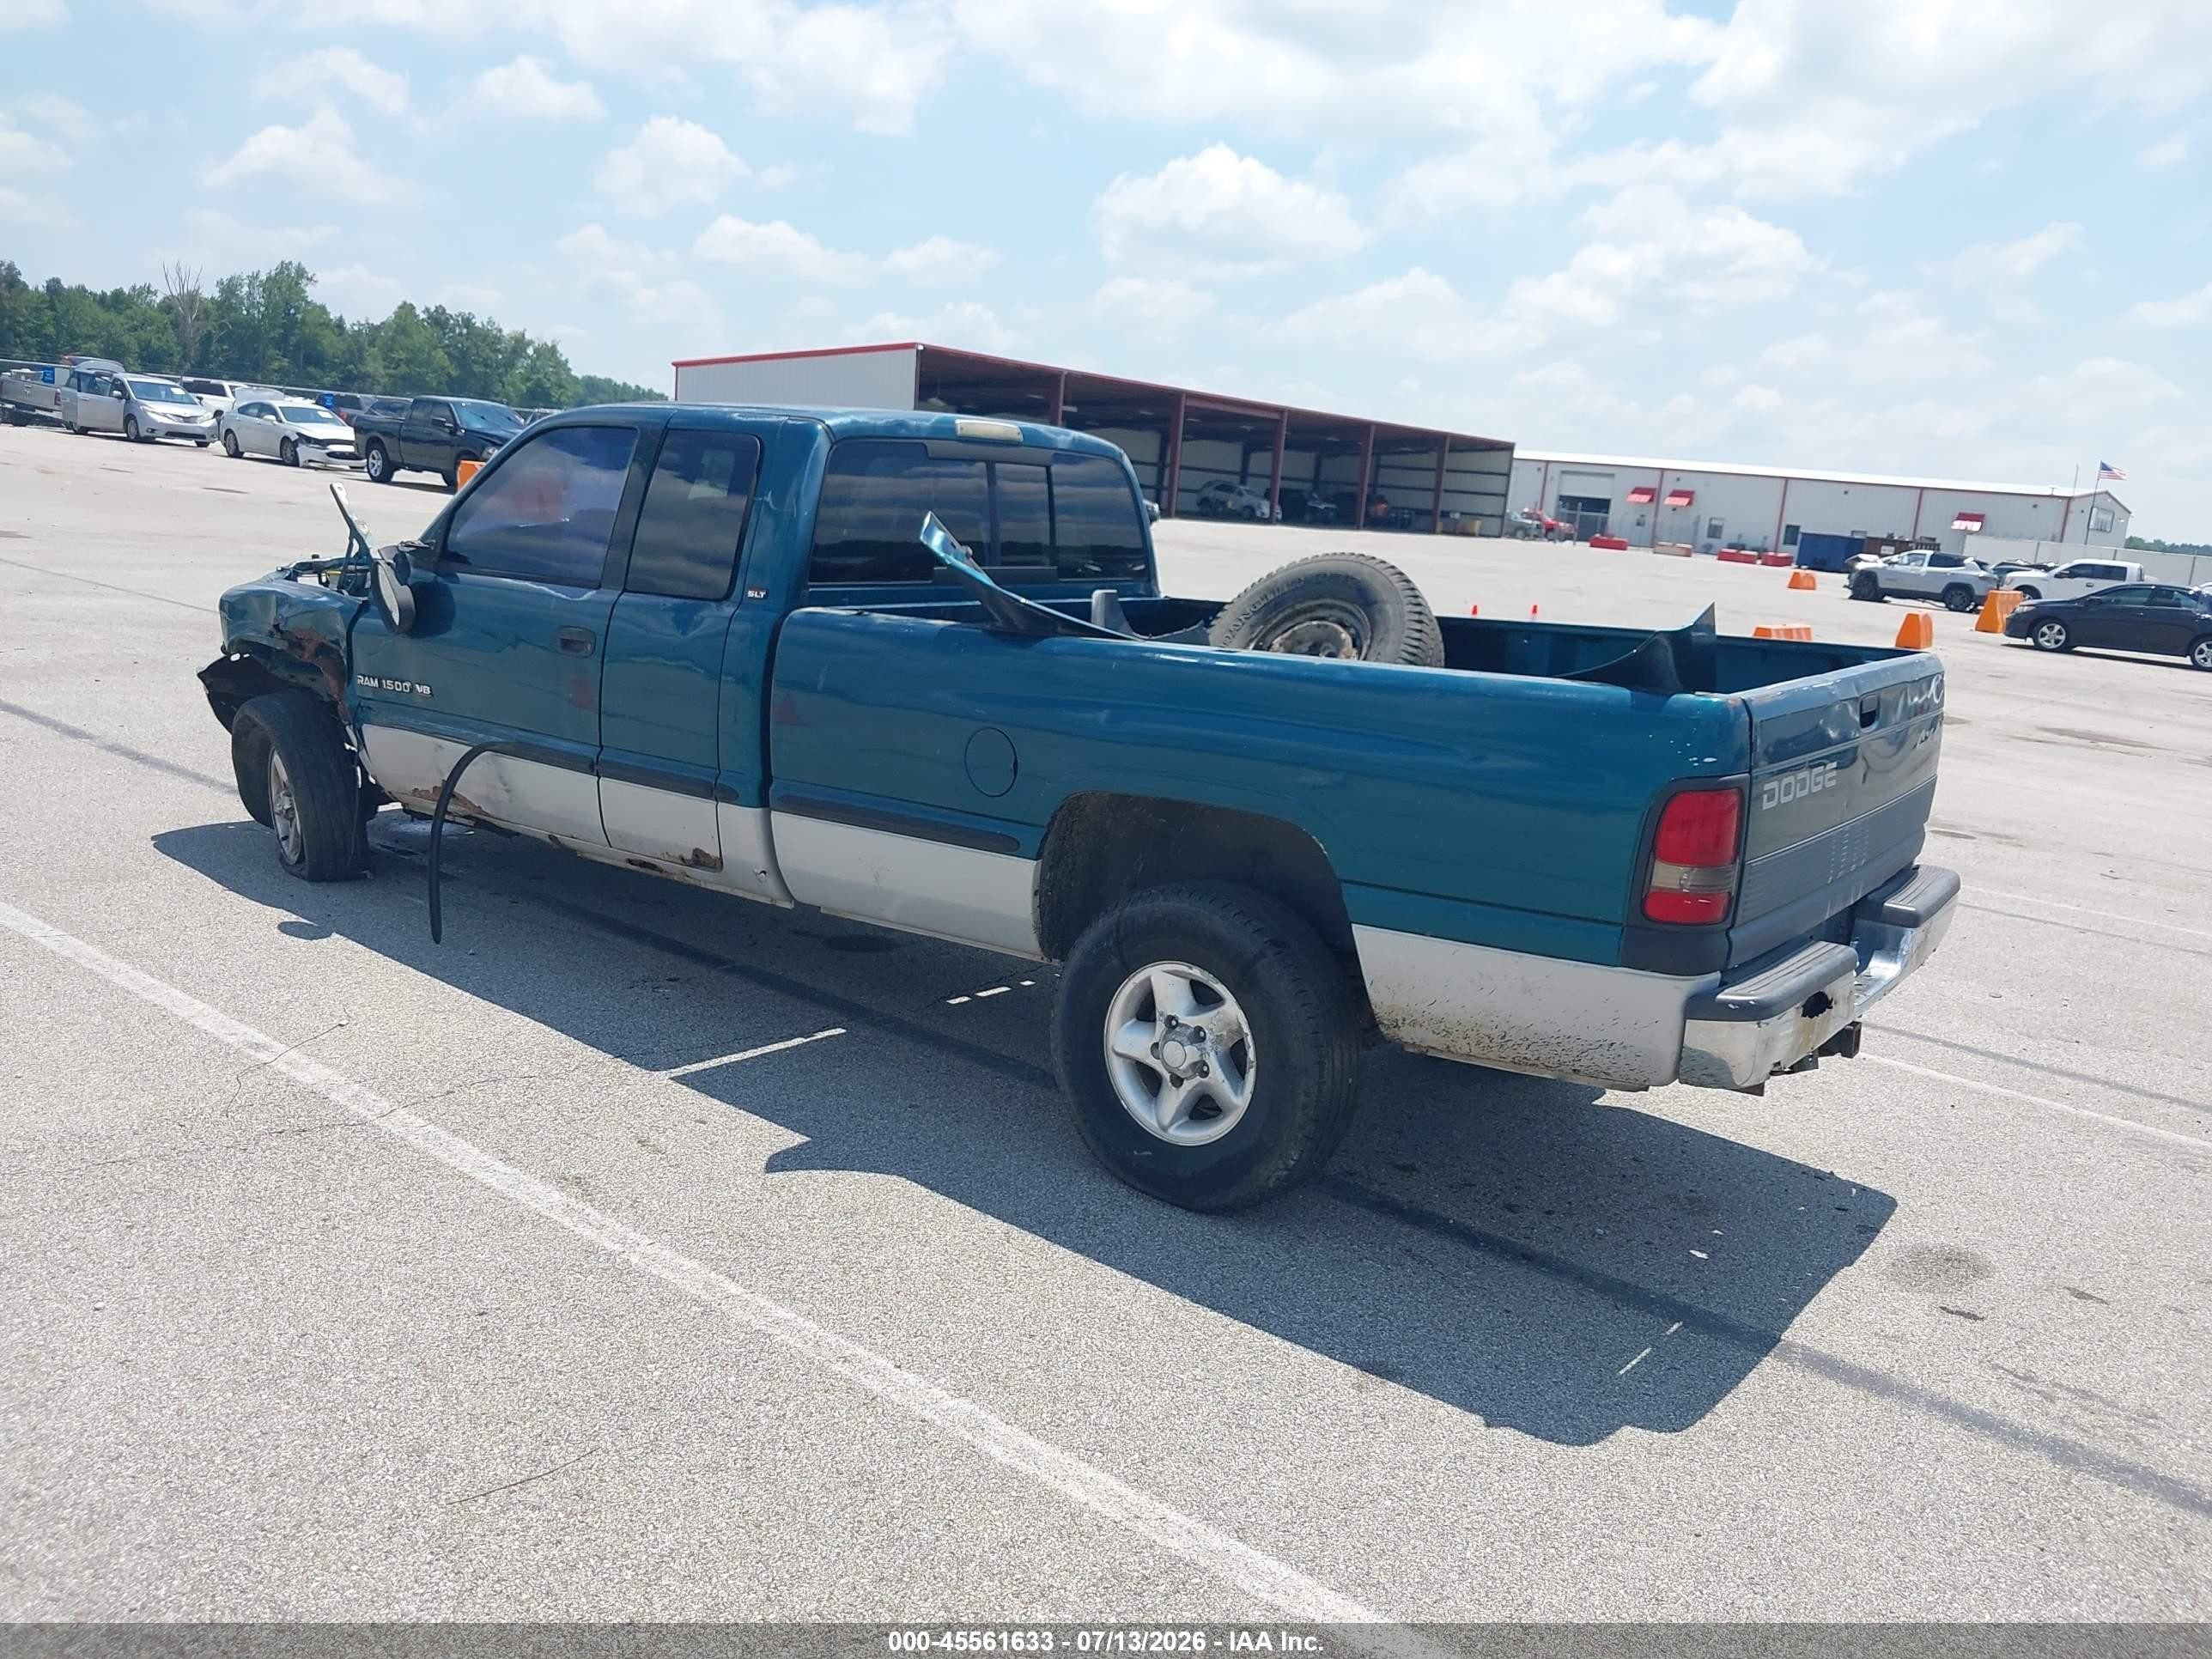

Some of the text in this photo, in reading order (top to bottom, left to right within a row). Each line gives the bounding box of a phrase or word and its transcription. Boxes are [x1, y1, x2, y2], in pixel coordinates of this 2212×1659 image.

[747, 590, 767, 599] SLT
[356, 674, 431, 695] RAM 1500 V8
[1762, 761, 1838, 811] DODGE
